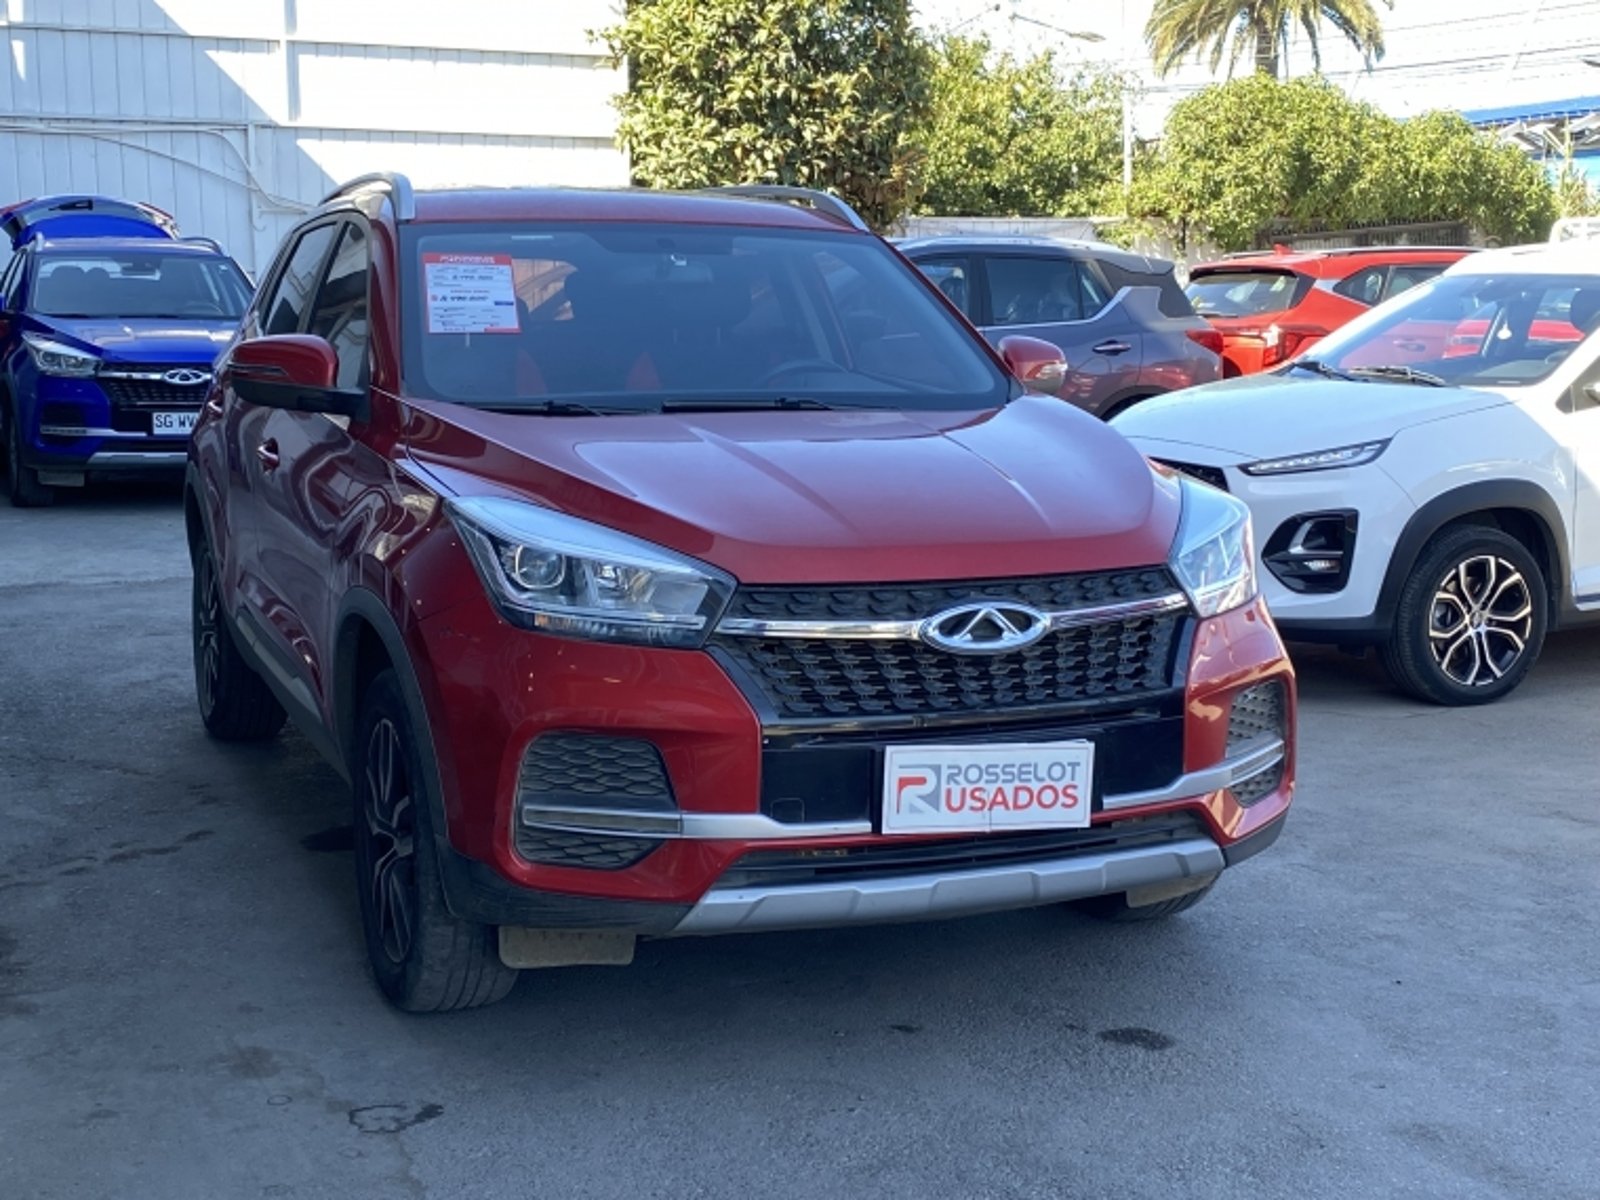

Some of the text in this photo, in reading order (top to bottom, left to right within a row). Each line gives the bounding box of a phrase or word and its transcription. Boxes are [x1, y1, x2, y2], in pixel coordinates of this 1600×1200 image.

[155, 414, 173, 428] SG
[946, 761, 1081, 786] ROSSELOT
[944, 783, 1079, 813] USADOS
